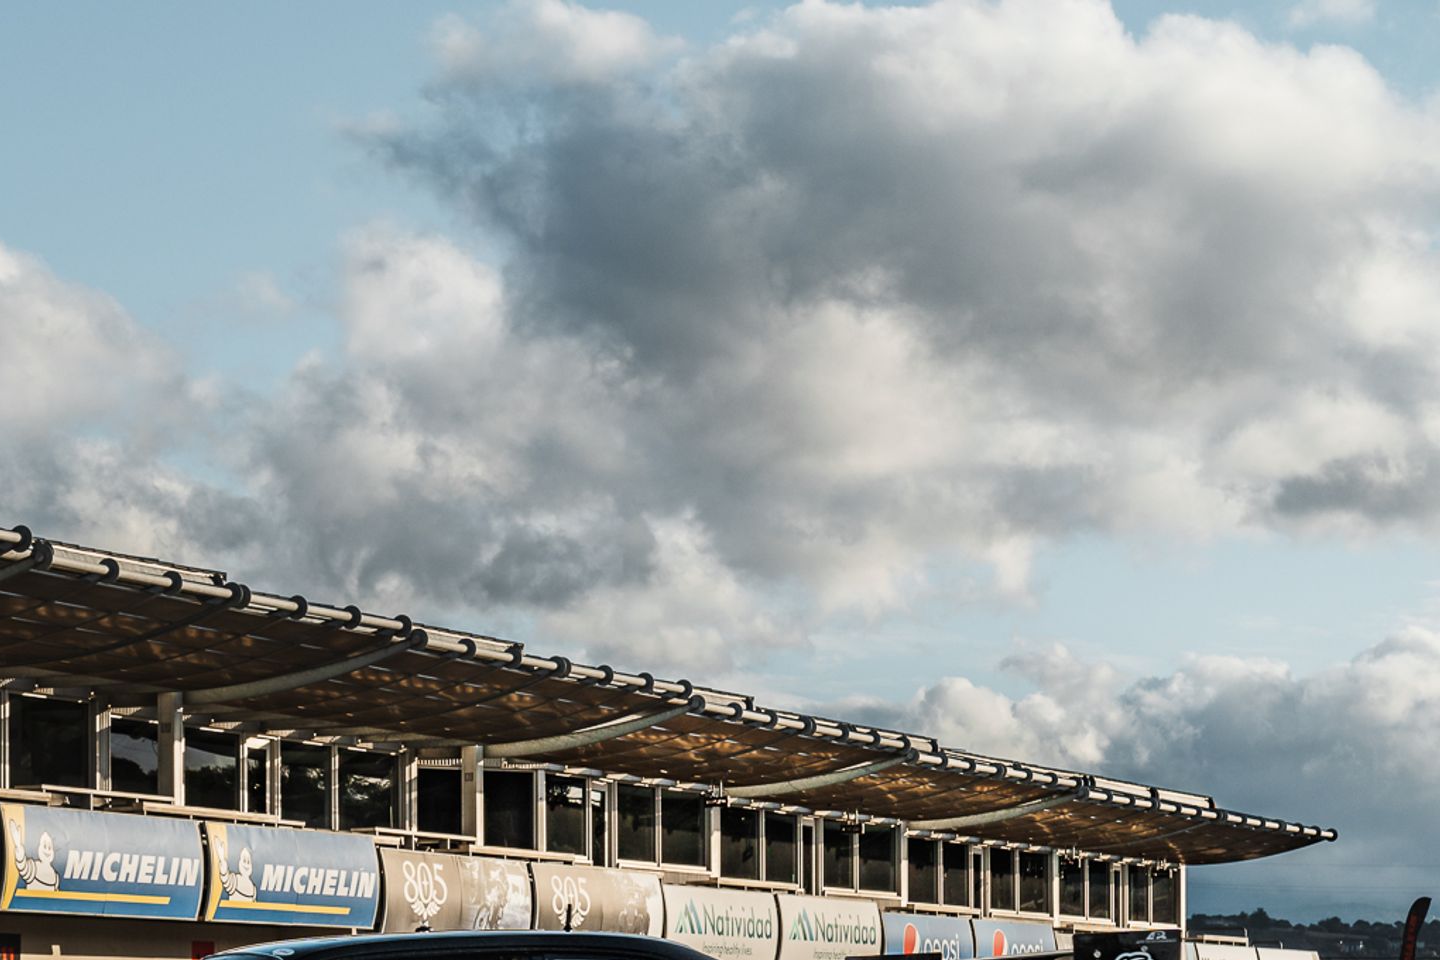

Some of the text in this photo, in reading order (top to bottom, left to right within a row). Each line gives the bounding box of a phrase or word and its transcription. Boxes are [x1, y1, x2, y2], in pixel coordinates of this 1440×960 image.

[63, 849, 200, 887] MICHELIN
[260, 864, 376, 898] MICHELIN
[403, 861, 448, 904] 805
[551, 875, 591, 916] 805
[703, 903, 772, 939] Natividad
[814, 912, 877, 945] Natividad
